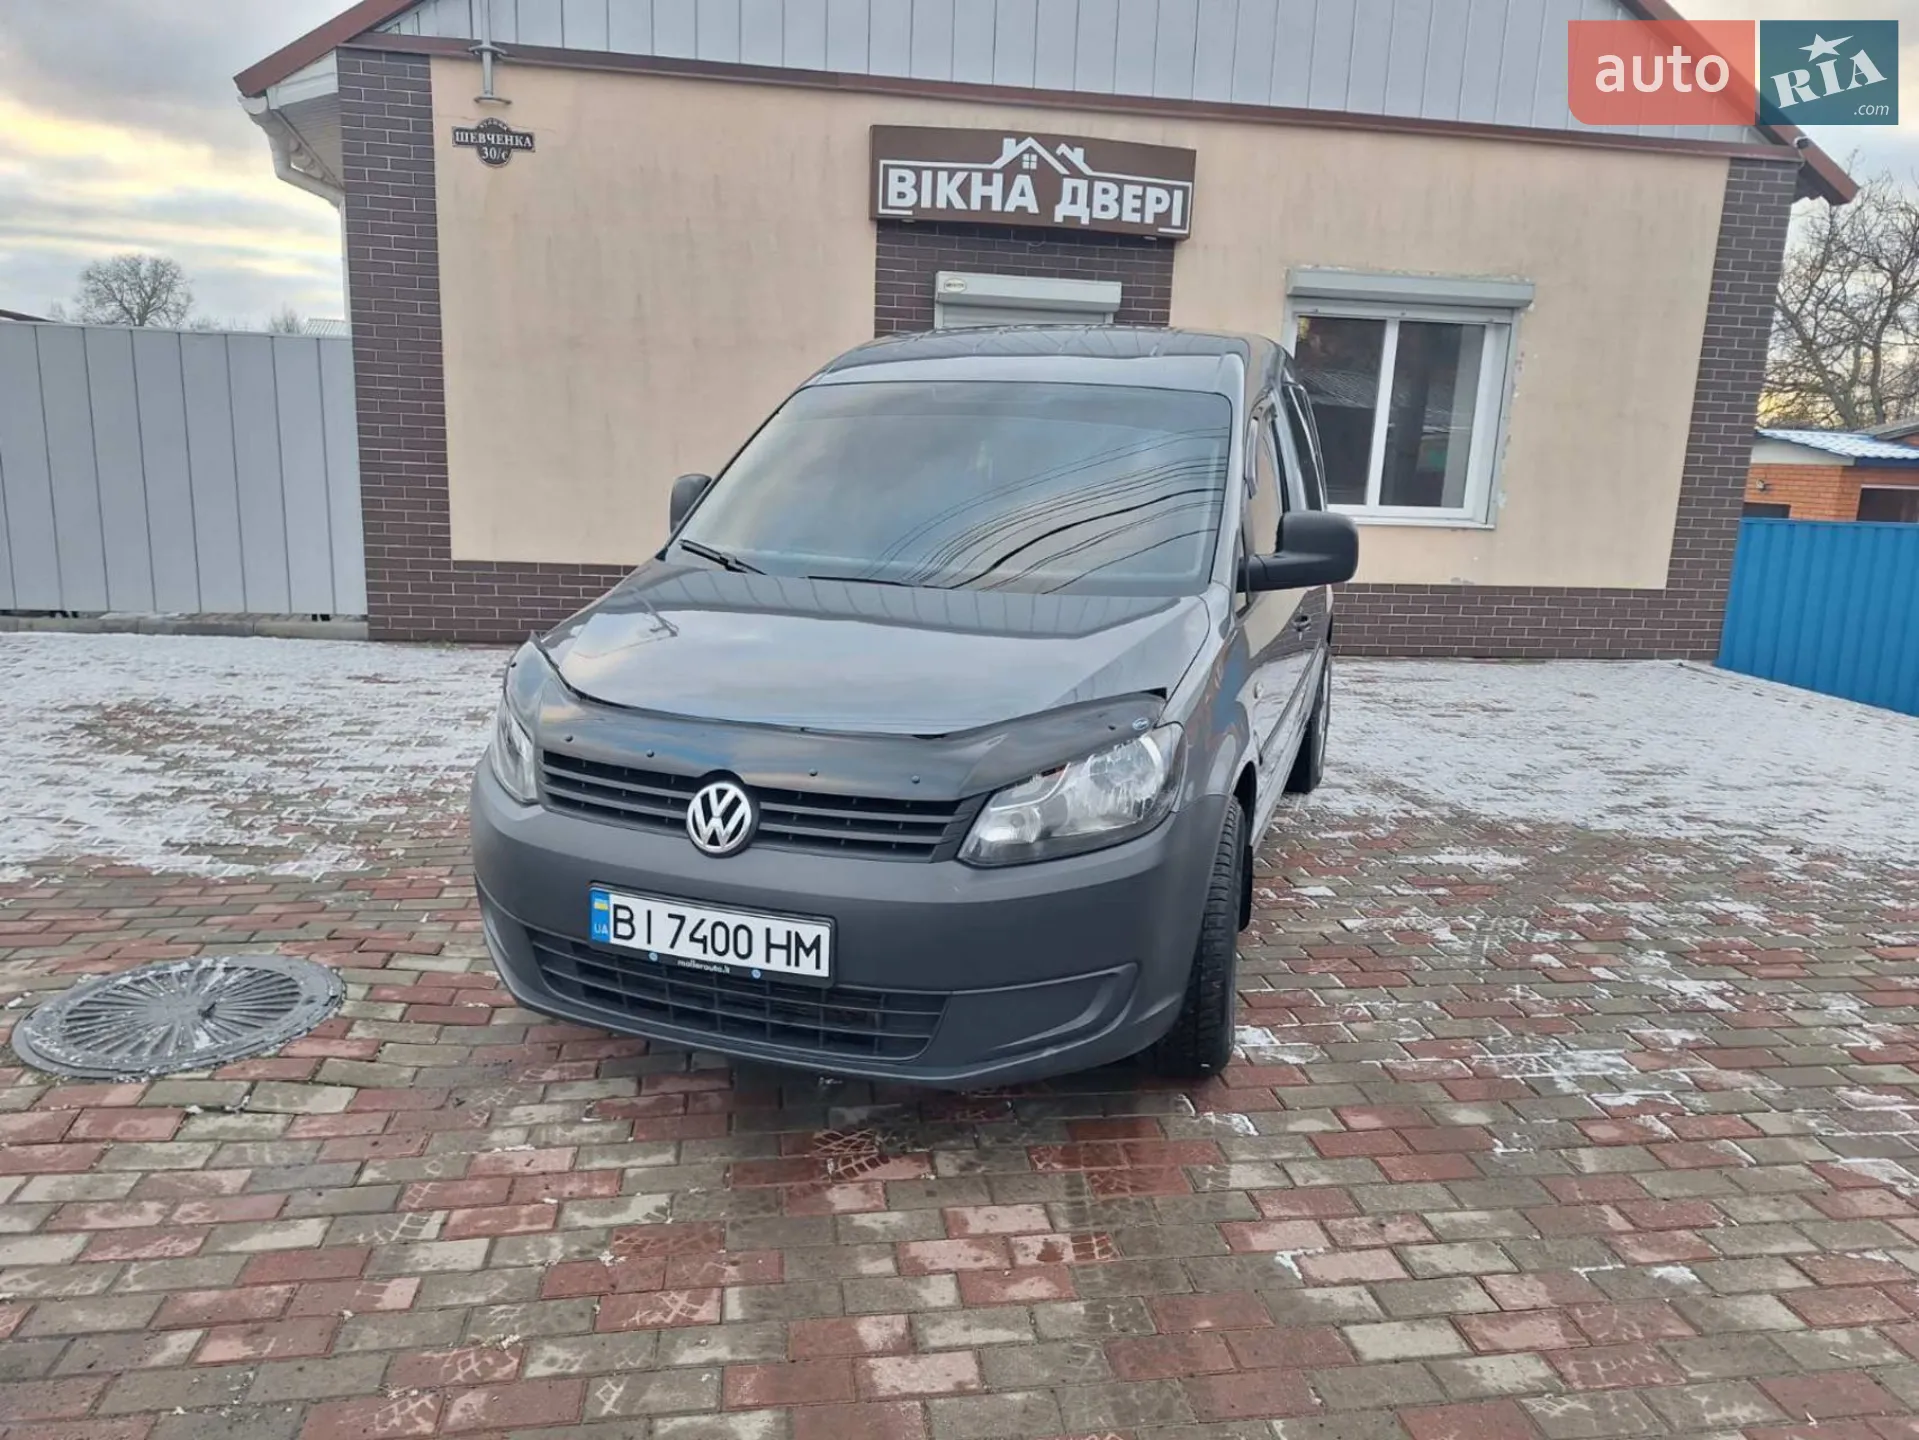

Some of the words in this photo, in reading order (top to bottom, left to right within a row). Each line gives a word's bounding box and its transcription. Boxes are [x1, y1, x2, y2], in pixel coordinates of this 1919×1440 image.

[455, 131, 532, 146] ШЕВЧЕНКА
[887, 168, 1040, 214] ВІКНА
[1053, 177, 1184, 226] ДВЕРІ
[594, 922, 609, 935] UA
[667, 913, 753, 960] 7400
[765, 927, 821, 970] HM
